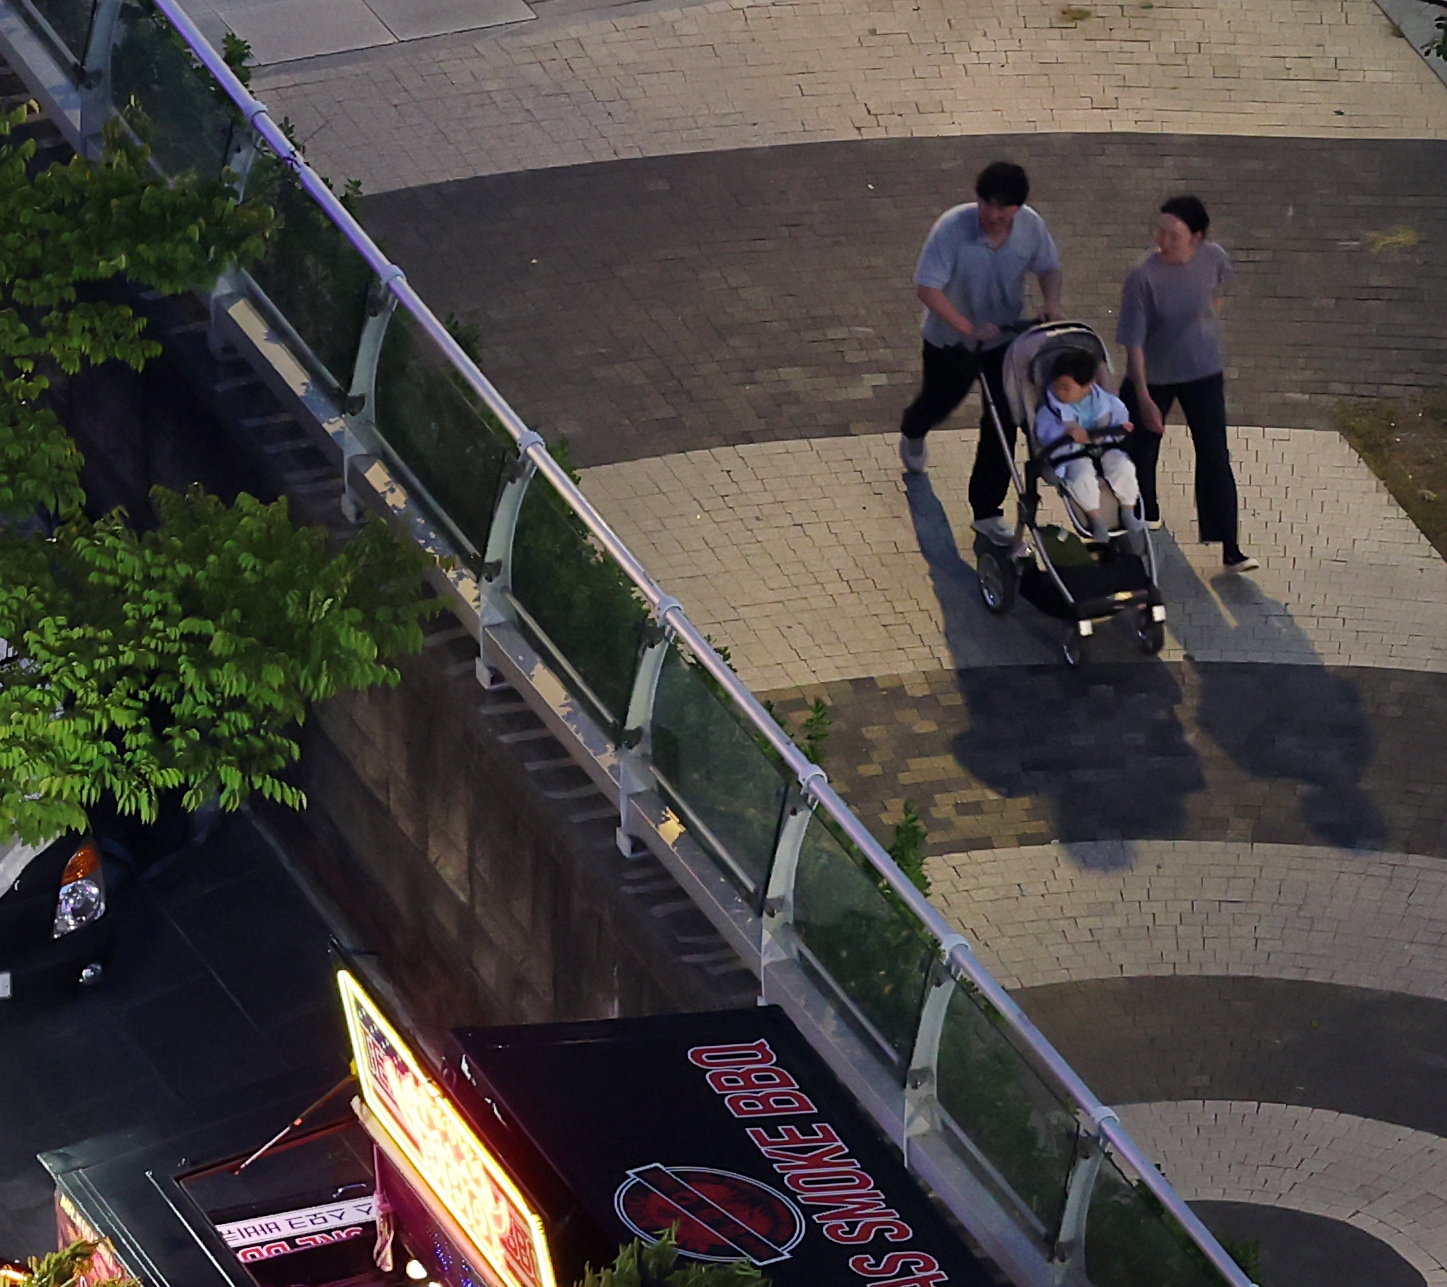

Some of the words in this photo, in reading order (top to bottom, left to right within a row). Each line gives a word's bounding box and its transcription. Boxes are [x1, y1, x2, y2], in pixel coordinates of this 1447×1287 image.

[687, 1038, 822, 1119] BBQ
[284, 1208, 345, 1230] 스모크
[746, 1121, 915, 1247] SMOKE
